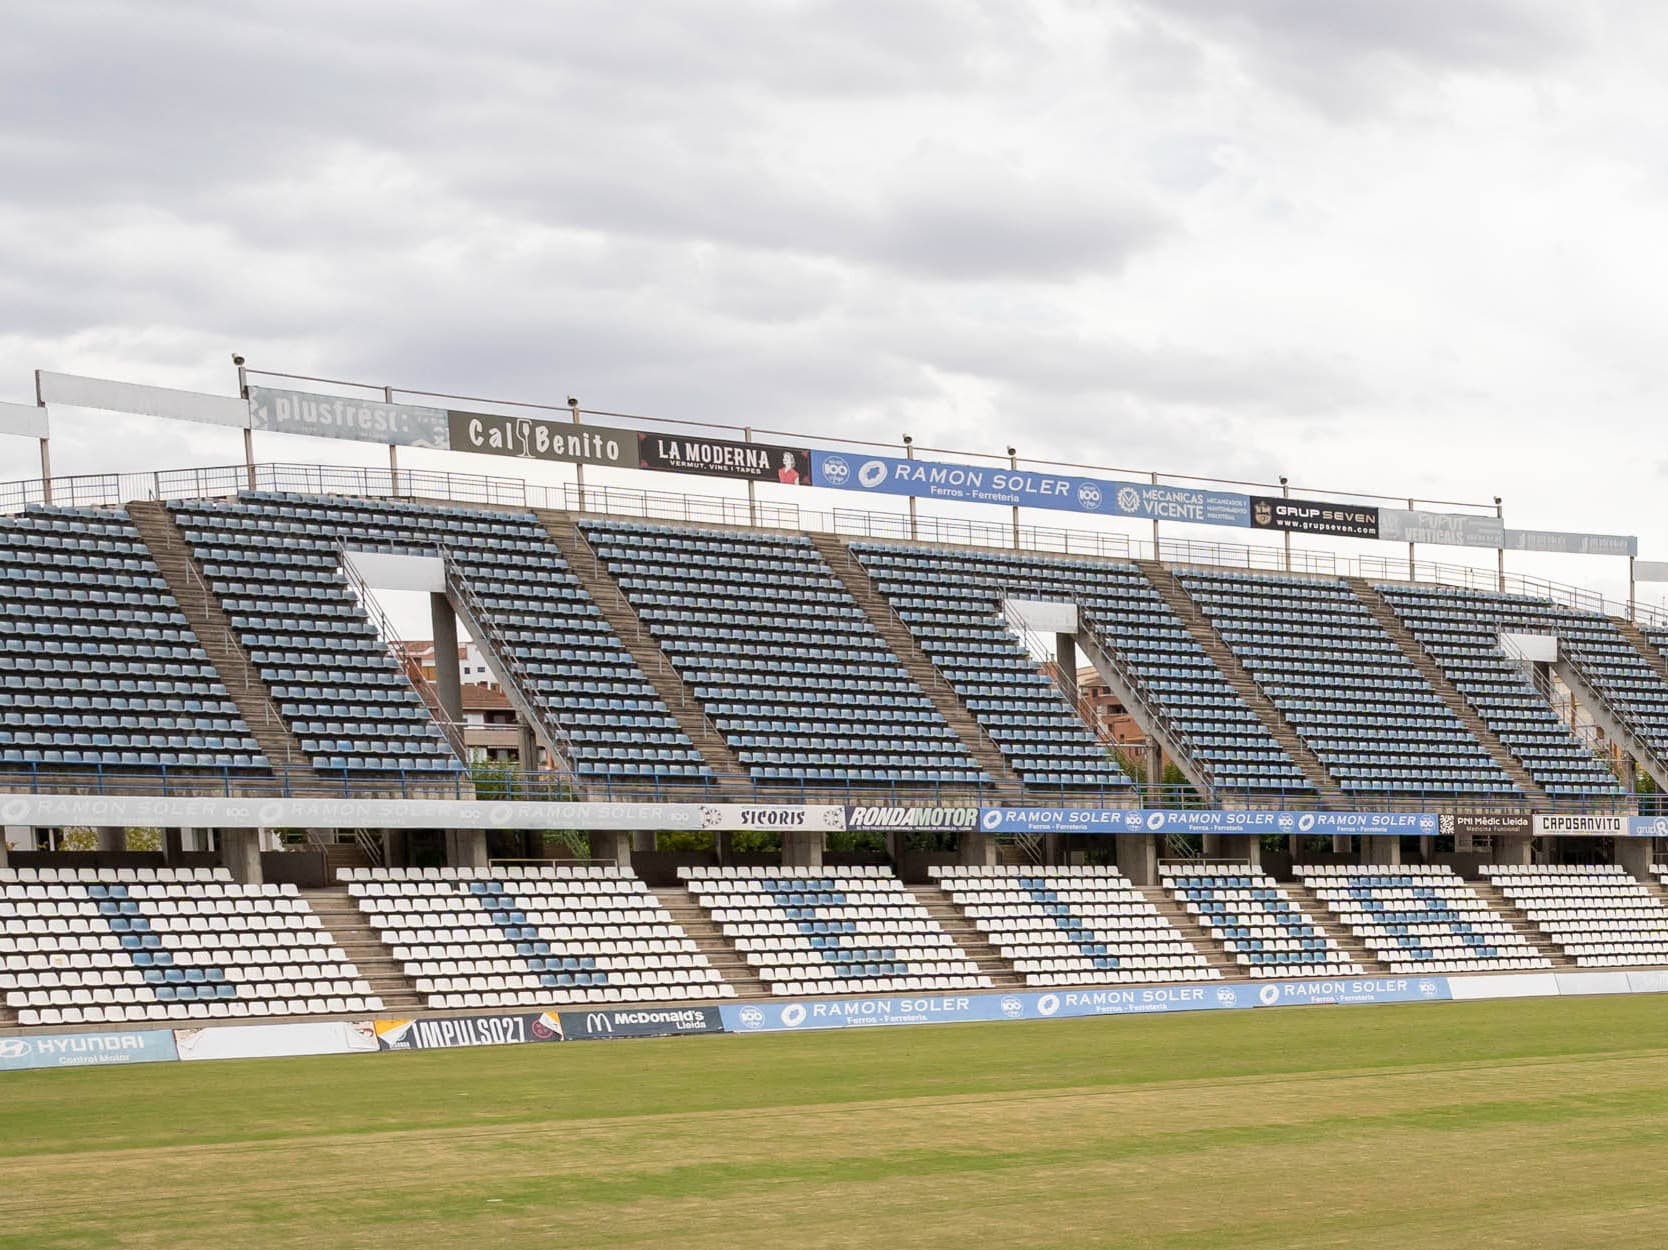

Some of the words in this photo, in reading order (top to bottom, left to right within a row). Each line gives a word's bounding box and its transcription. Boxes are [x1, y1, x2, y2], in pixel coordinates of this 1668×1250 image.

[469, 418, 512, 450] Cal
[535, 425, 620, 460] Benito
[658, 439, 681, 460] LA
[685, 442, 770, 469] MODERNA
[709, 463, 729, 472] VINS
[736, 467, 762, 475] TAPES
[894, 464, 983, 487] RAMON
[992, 475, 1070, 497] SOLER
[931, 486, 963, 497] Ferros
[972, 490, 1020, 503] Ferreteria
[1142, 489, 1204, 504] MECANICAS
[1143, 502, 1205, 520] VICENTE
[1276, 505, 1320, 518] GRUP
[1322, 508, 1376, 524] SEVEN
[1276, 519, 1377, 535] www.grupseven.com
[38, 799, 126, 816] RAMON
[139, 799, 217, 816] SOLER
[290, 801, 370, 817] RAMON
[377, 802, 452, 817] SOLER
[518, 805, 591, 819] RAMON
[600, 805, 663, 819] SOLER
[740, 810, 806, 826] SICORIS
[848, 806, 979, 827] RONDAMOTOR
[1005, 811, 1063, 823] RAMON
[1068, 812, 1121, 823] SOLER
[1167, 814, 1221, 824] RAMON
[1226, 814, 1275, 825] SOLER
[1317, 815, 1367, 825] RAMON
[1371, 815, 1417, 826] SOLER
[1502, 817, 1529, 826] Lleida
[1543, 817, 1621, 831] CAPOSANVITO
[1284, 983, 1345, 997] RAMON
[1352, 980, 1407, 993] SOLER
[1065, 992, 1134, 1006] RAMON
[1142, 989, 1204, 1002] SOLER
[813, 1001, 892, 1017] RAMON
[900, 998, 969, 1013] SOLER
[614, 1010, 705, 1026] McDonald's
[676, 1021, 706, 1031] Lleida
[846, 1016, 877, 1025] Ferros
[412, 1017, 526, 1049] IMPULSO27
[36, 1035, 145, 1055] HYUNDAI
